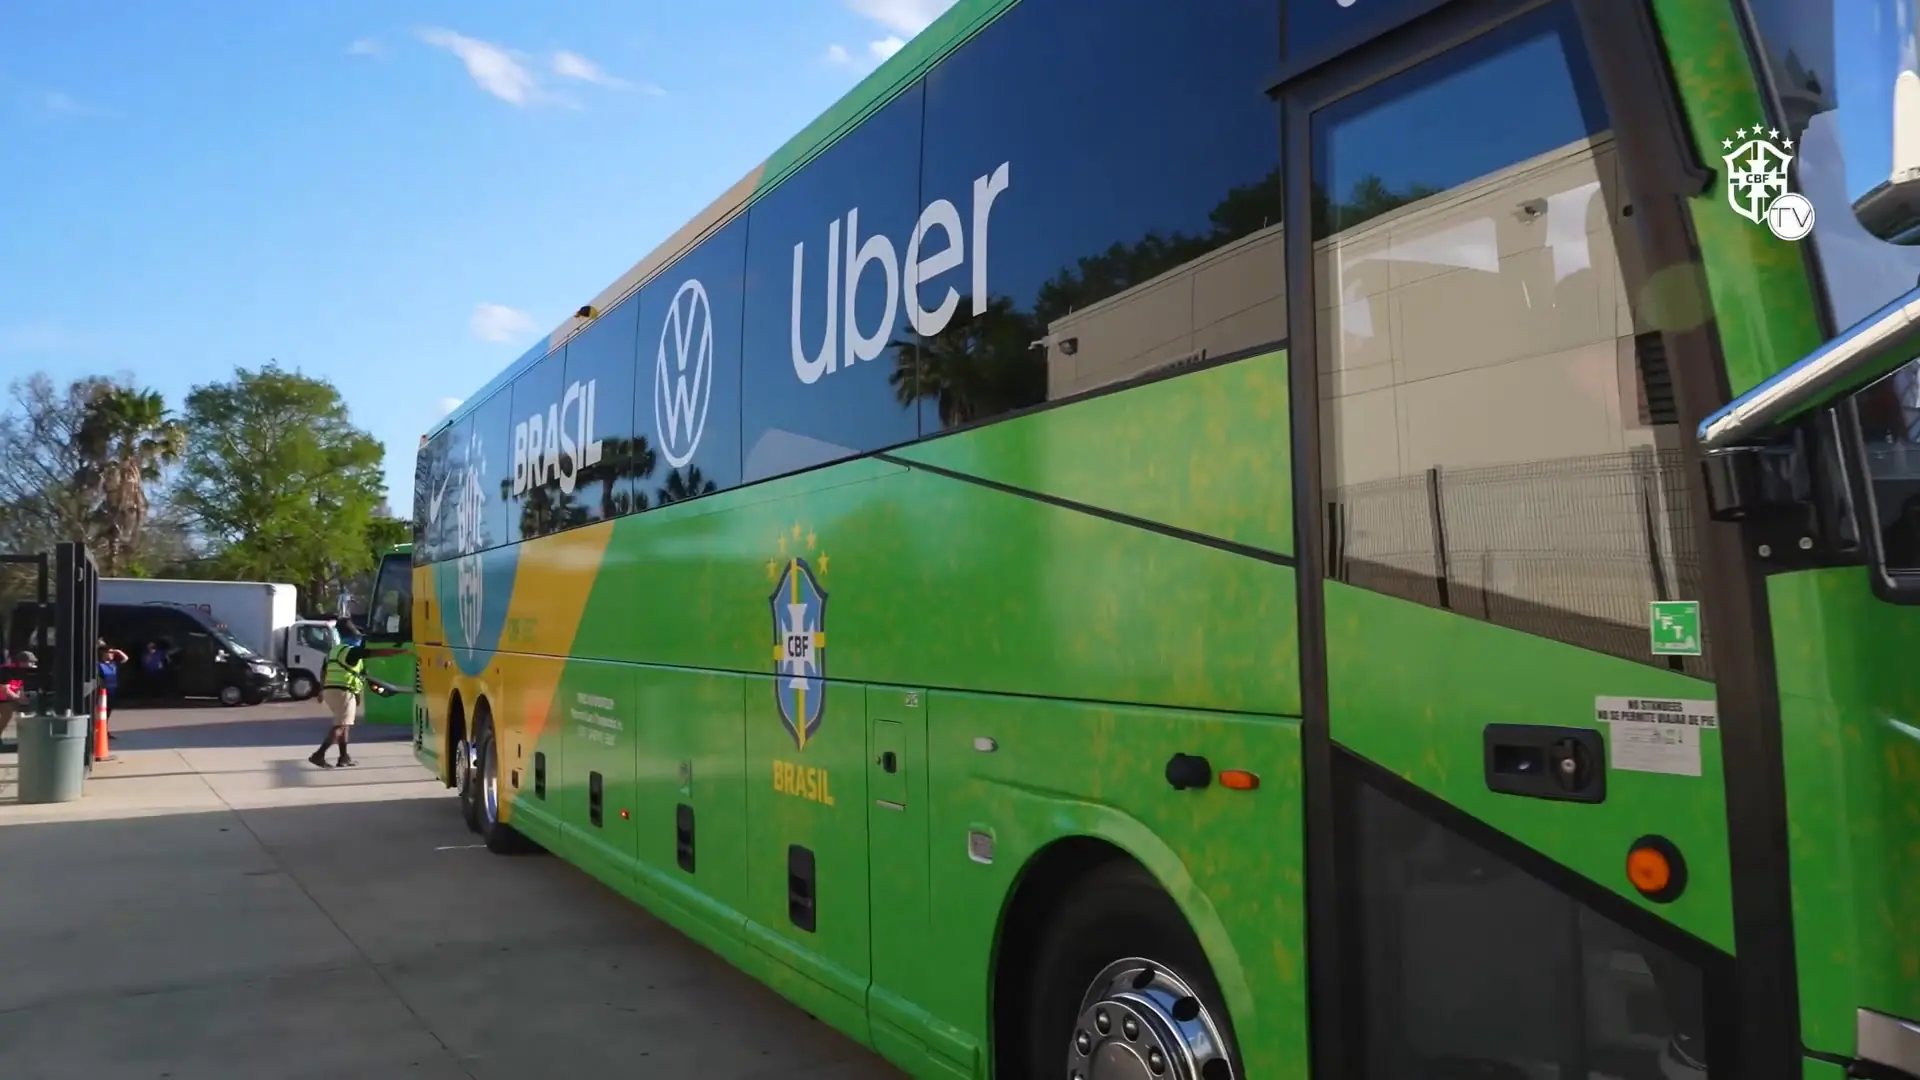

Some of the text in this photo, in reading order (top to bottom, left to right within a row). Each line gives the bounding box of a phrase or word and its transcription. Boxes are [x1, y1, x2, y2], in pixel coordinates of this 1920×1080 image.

[791, 161, 1010, 384] Uber
[513, 378, 603, 494] BRASIL
[787, 635, 809, 658] CBF
[773, 759, 835, 806] BRASIL
